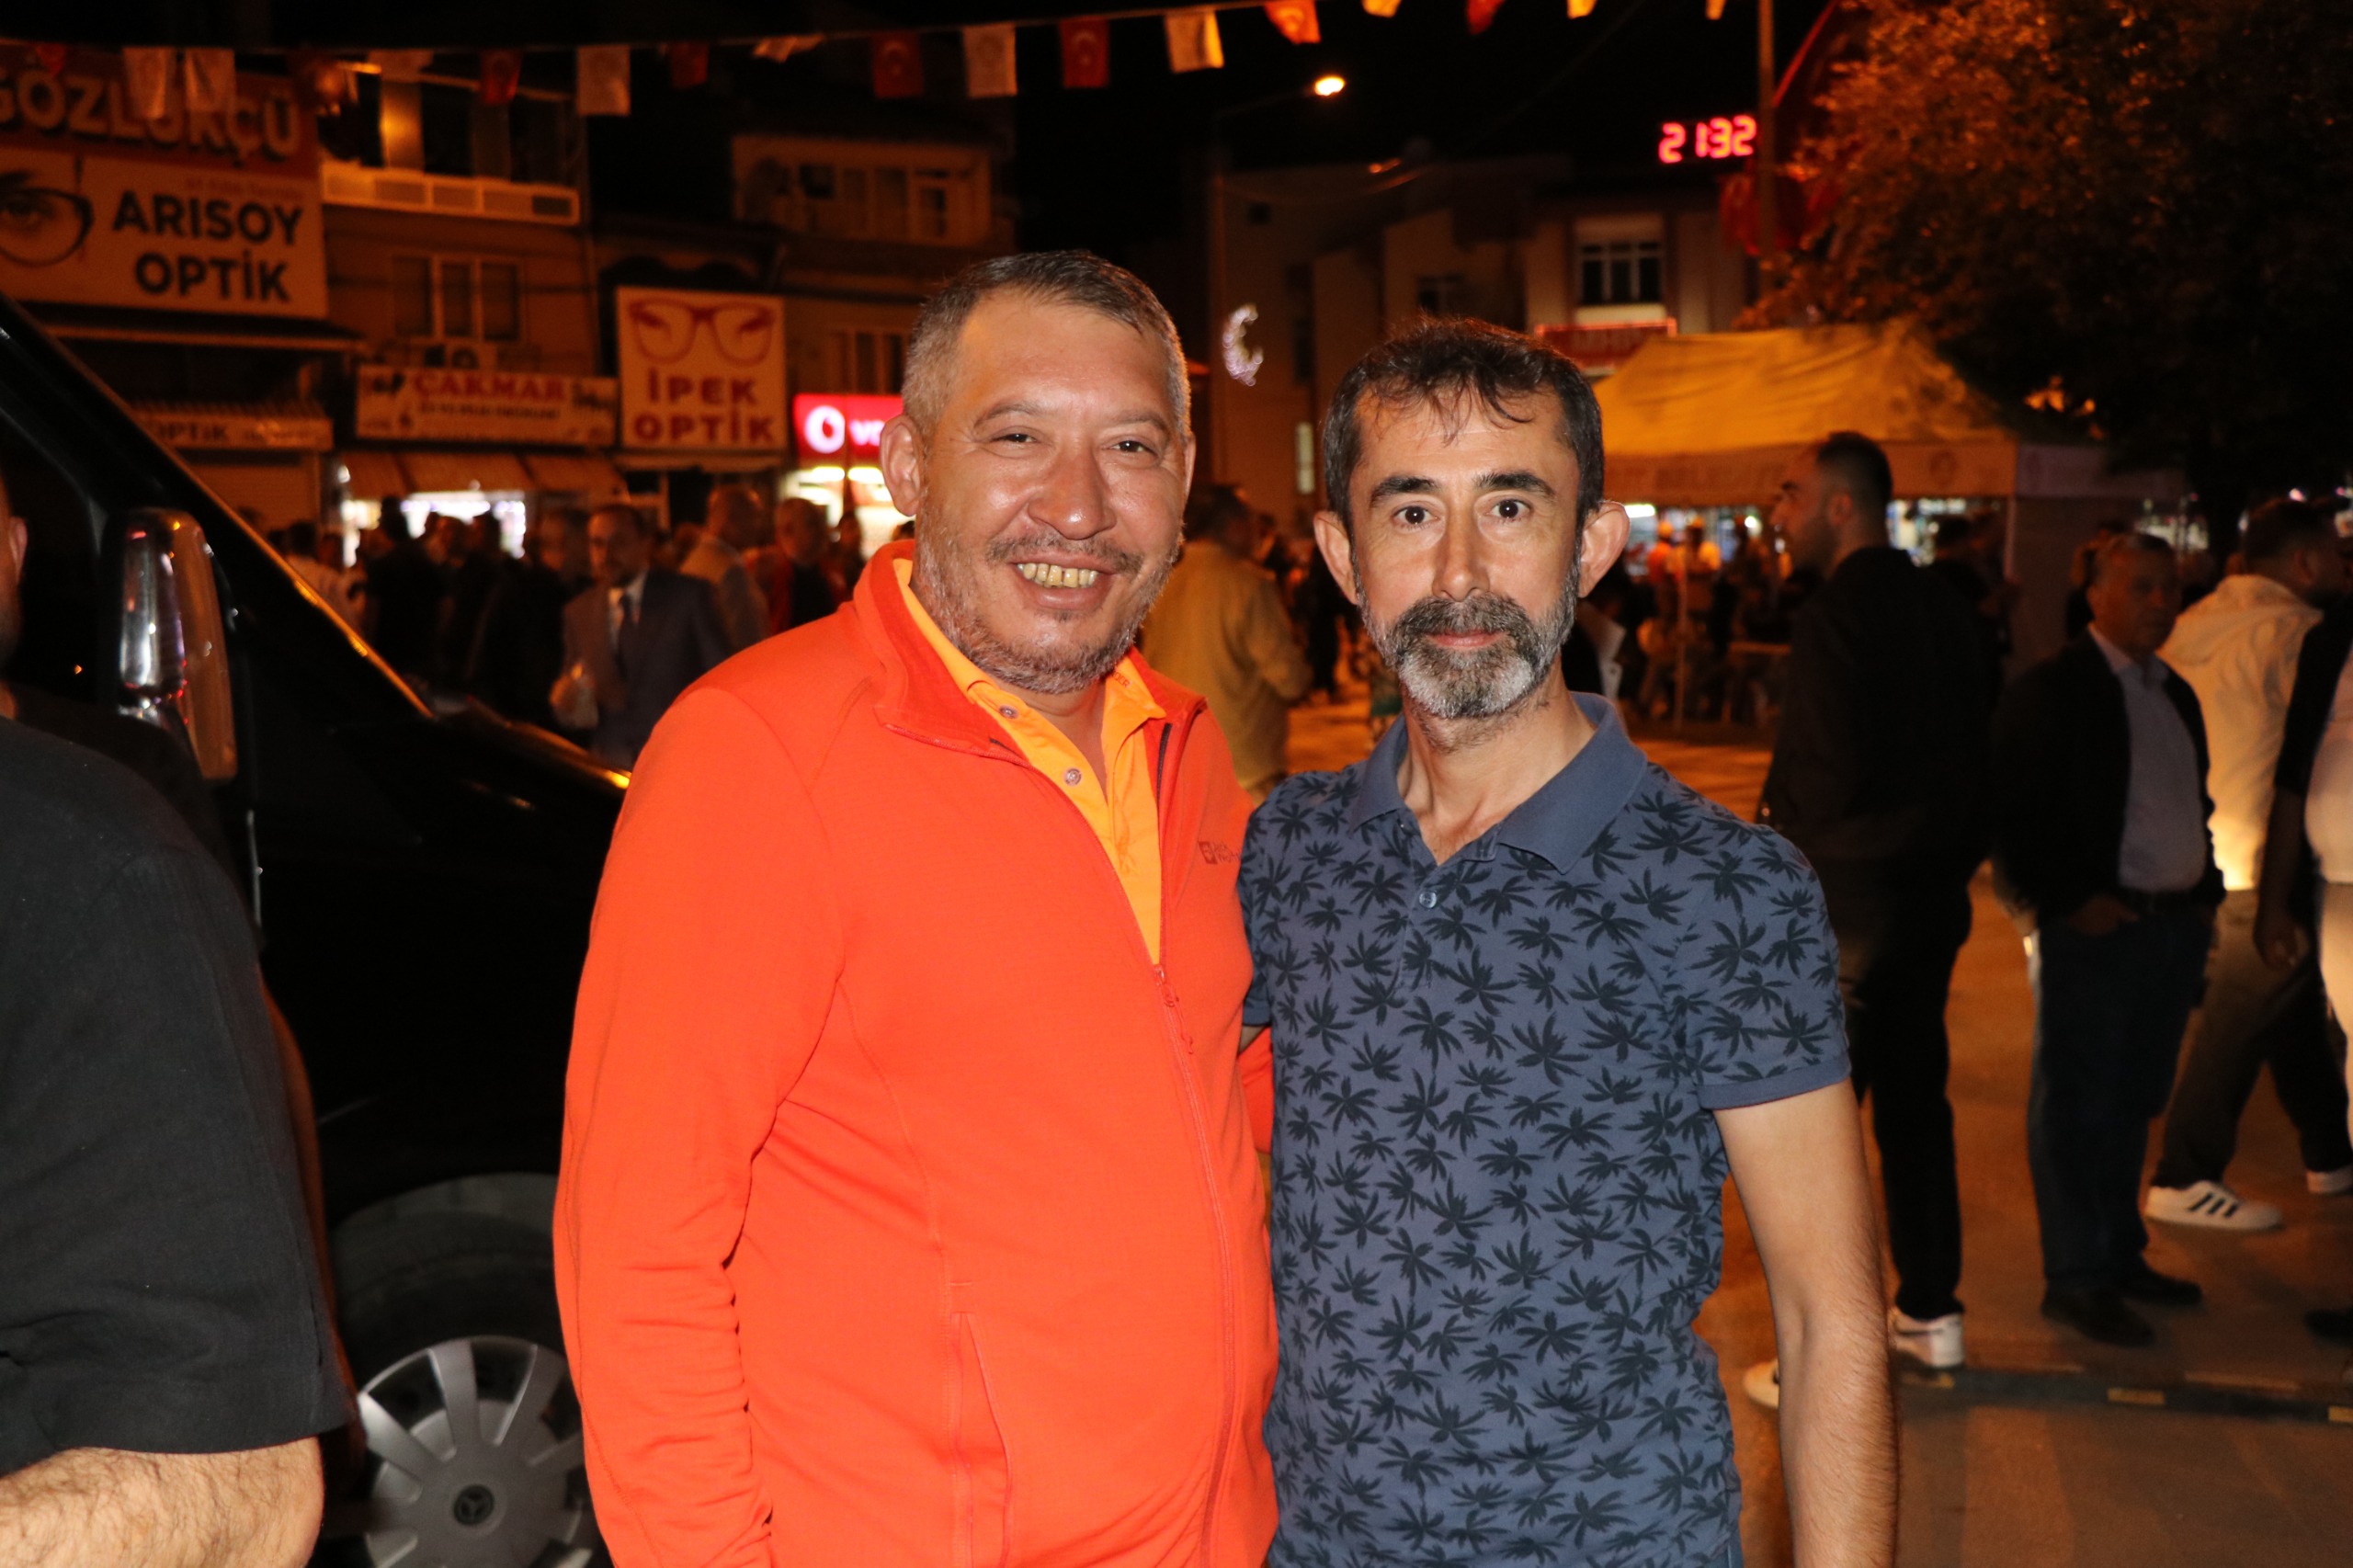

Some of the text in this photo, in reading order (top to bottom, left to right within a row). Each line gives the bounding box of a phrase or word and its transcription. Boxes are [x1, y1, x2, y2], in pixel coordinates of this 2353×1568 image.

[112, 190, 302, 246] ARISOY
[135, 249, 291, 302] OPTİK
[649, 368, 757, 404] İPEK
[634, 407, 774, 443] OPTİK
